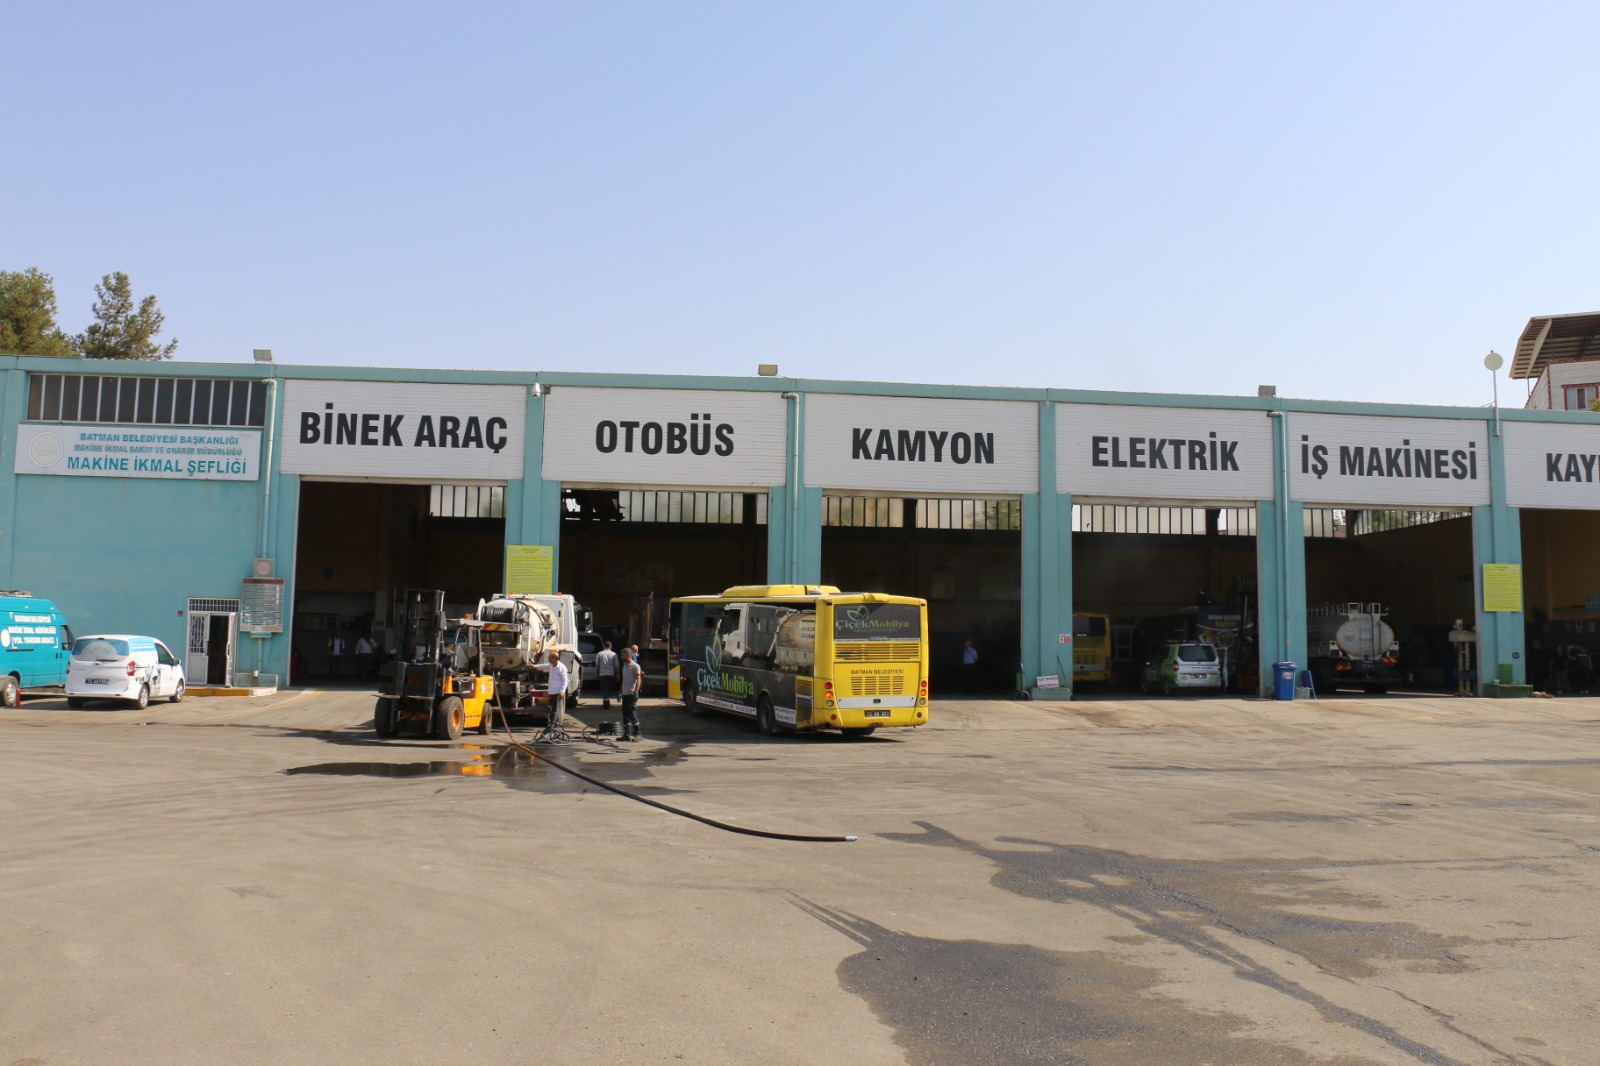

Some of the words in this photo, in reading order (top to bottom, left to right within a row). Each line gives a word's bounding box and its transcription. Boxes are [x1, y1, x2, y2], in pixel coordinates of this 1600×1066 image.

[80, 432, 120, 442] BATMAN
[122, 433, 178, 444] BELEDİYESİ
[179, 435, 239, 446] BAŞKANLIĞI
[300, 403, 404, 446] BİNEK
[414, 415, 508, 454] ARAÇ
[596, 413, 734, 456] OTOBÜS
[852, 428, 994, 464] KAMYON
[67, 454, 129, 471] MAKİNE
[133, 455, 183, 473] İKMAL
[187, 458, 247, 477] ŞEFLİĞİ
[74, 442, 103, 452] MAKİNE
[104, 443, 128, 453] İKMAL
[155, 446, 165, 455] VE
[1092, 432, 1240, 471] ELEKTRİK
[1302, 435, 1328, 479] İŞ
[1340, 439, 1477, 480] MAKİNESİ
[1546, 452, 1600, 483] KAY
